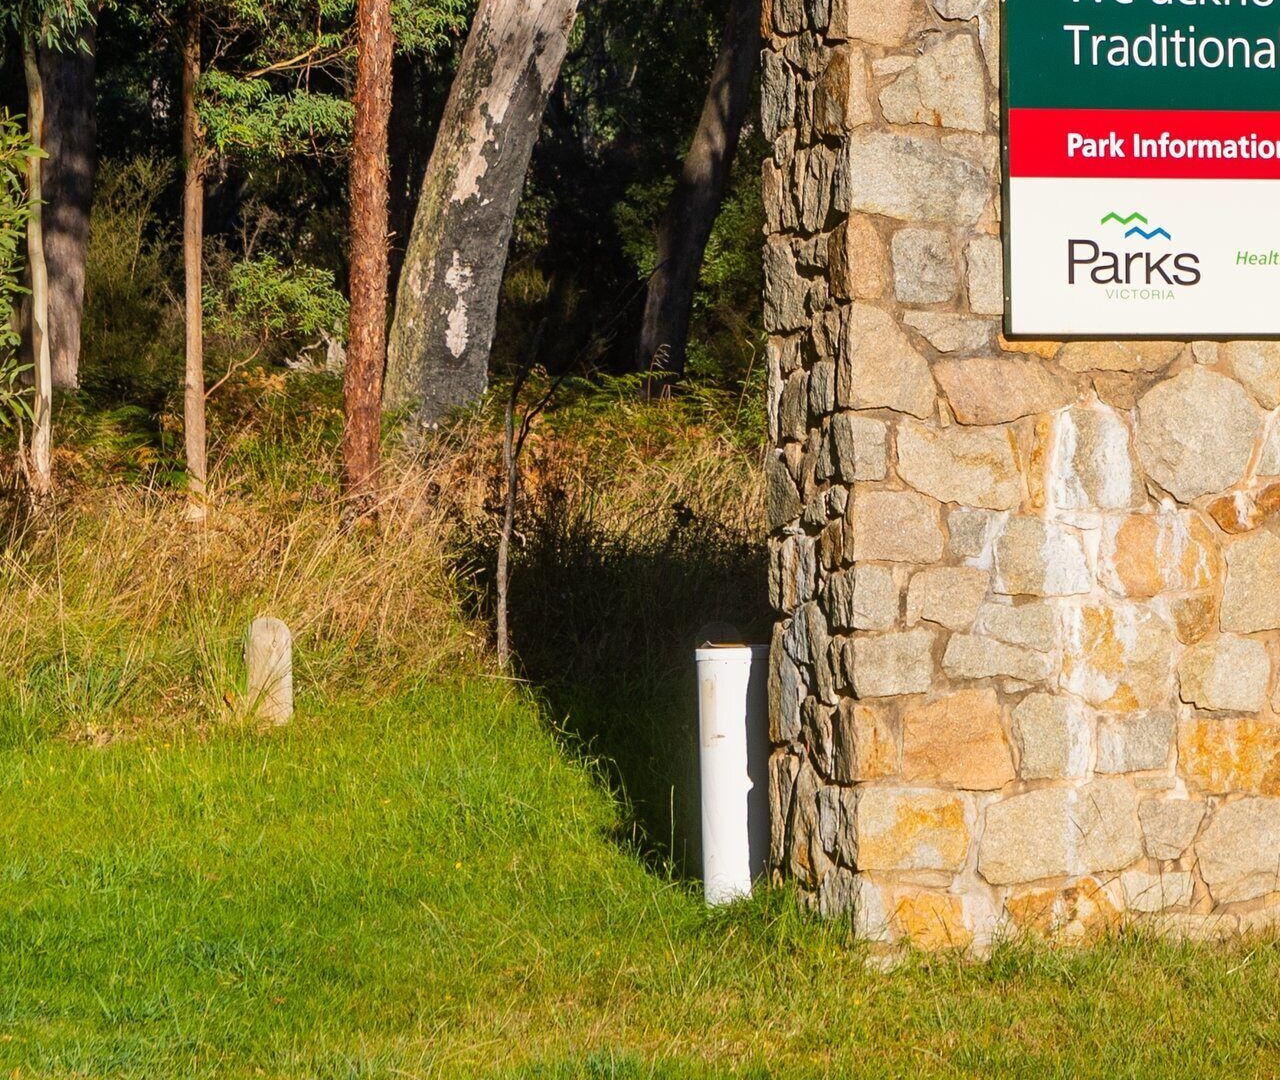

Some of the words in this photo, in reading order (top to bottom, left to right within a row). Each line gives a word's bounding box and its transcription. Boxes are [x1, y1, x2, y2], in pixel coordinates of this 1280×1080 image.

[1067, 131, 1126, 159] Park
[1067, 238, 1201, 286] Parks
[1105, 288, 1175, 300] VICTORIA
